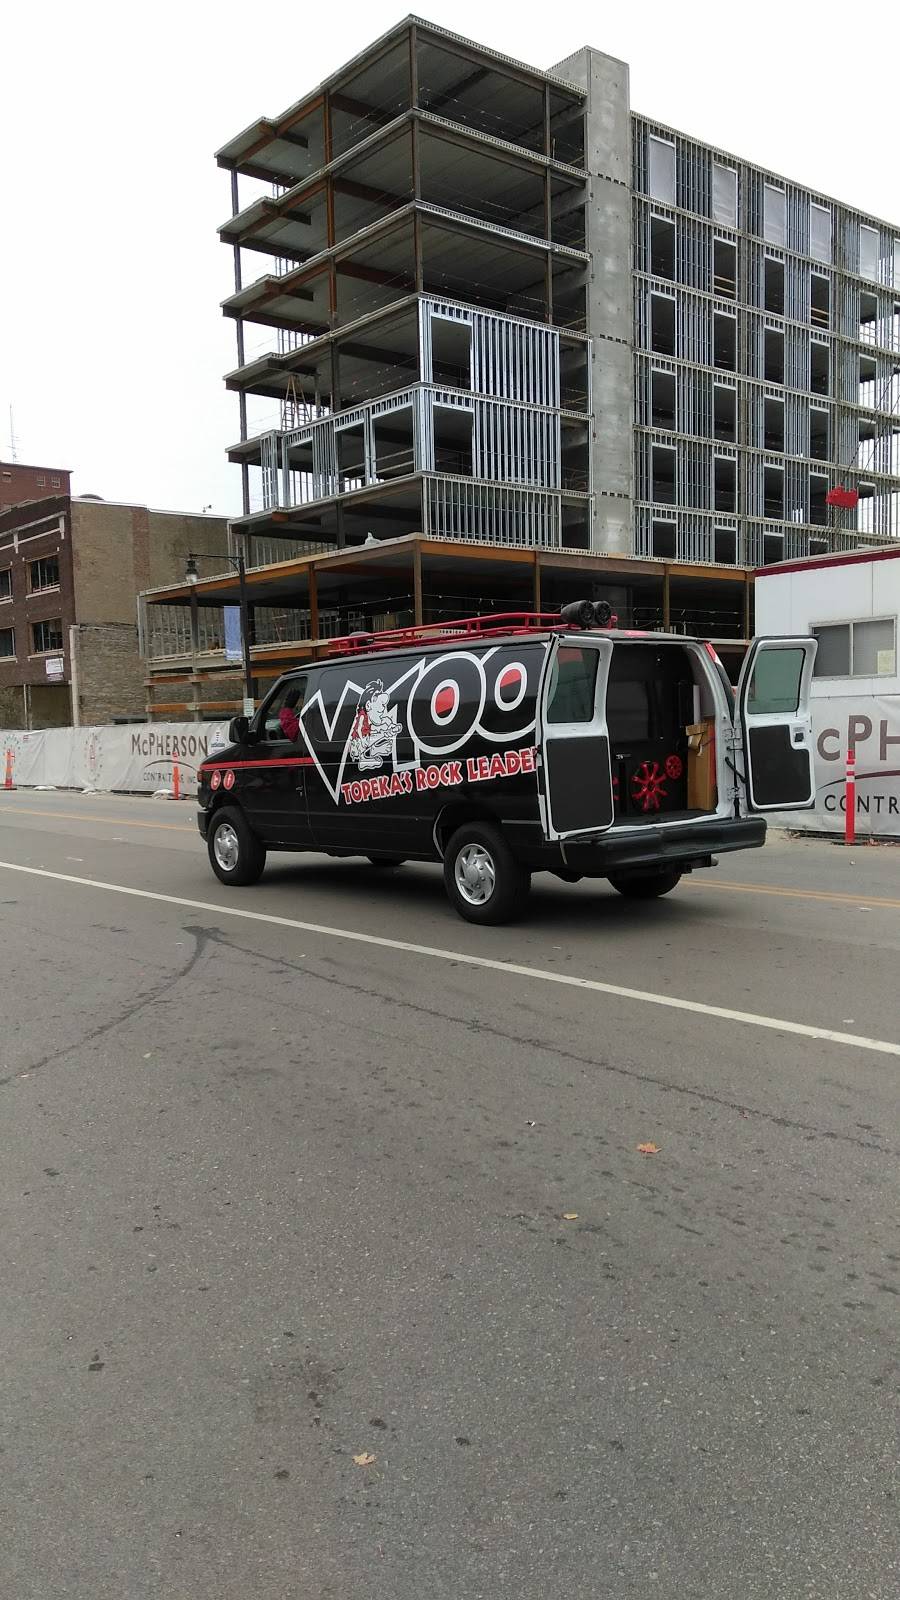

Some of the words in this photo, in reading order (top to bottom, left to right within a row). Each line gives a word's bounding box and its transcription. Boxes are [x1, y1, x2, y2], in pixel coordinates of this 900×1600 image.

[131, 732, 208, 757] McPHERSON
[341, 772, 413, 805] TOPEKA'S
[416, 761, 462, 792] ROCK
